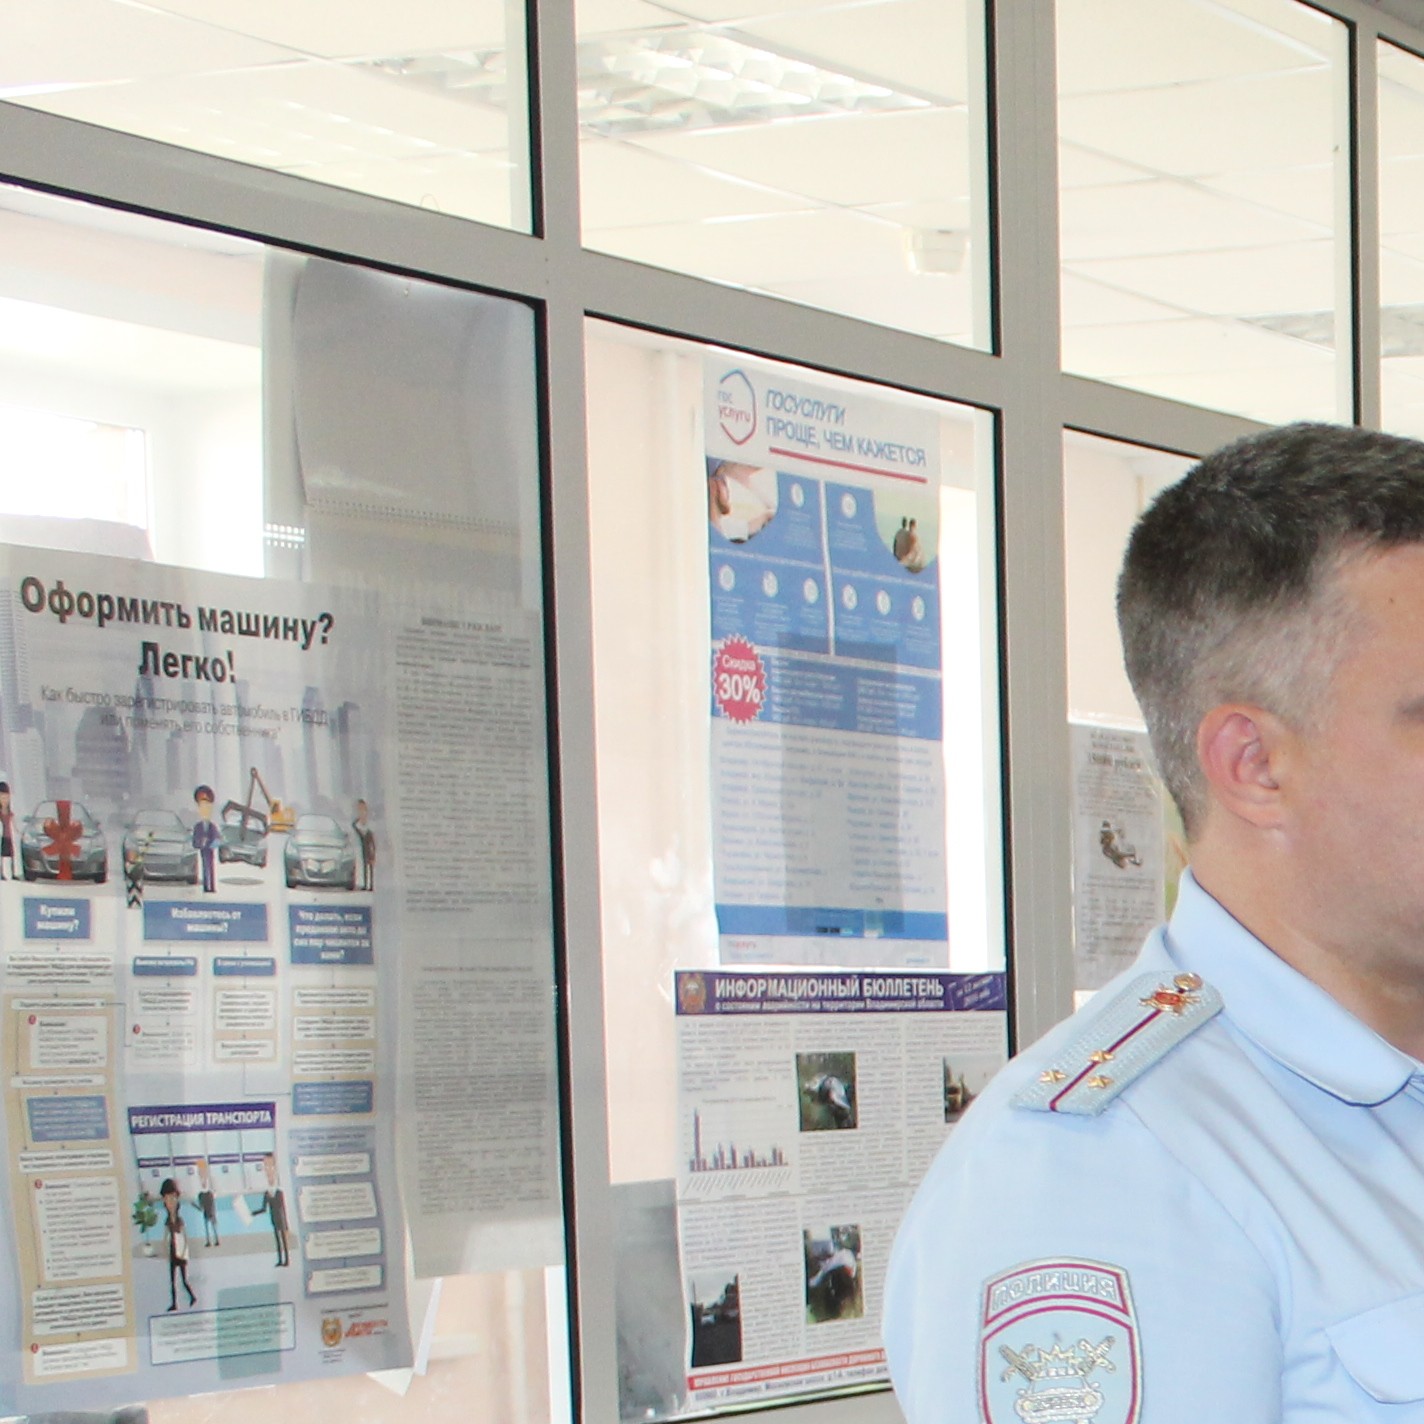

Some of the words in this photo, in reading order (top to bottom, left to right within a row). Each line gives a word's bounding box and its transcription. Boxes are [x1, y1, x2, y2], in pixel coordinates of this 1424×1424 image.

[765, 388, 846, 426] ГОСУСЛУГИ
[766, 416, 821, 450] ПРОЩЕ,
[823, 430, 853, 455] ЧЕМ
[857, 437, 928, 468] КАЖЕТСЯ
[20, 576, 192, 628] Оформить
[198, 605, 336, 651] машину?
[138, 641, 237, 683] Легко!
[722, 655, 757, 672] Скидка
[41, 684, 66, 702] Как
[66, 687, 112, 706] быстро
[719, 673, 761, 703] 30%
[715, 975, 860, 1000] ИНФОРМАЦИОННЫЙ
[863, 977, 945, 997] БЮЛЛЕТЕНЬ
[131, 1112, 205, 1128] РЕГИСТРАЦИЯ
[206, 1110, 272, 1125] ТРАНСПОРТА
[990, 1270, 1118, 1310] ПОЛИЦИЯ
